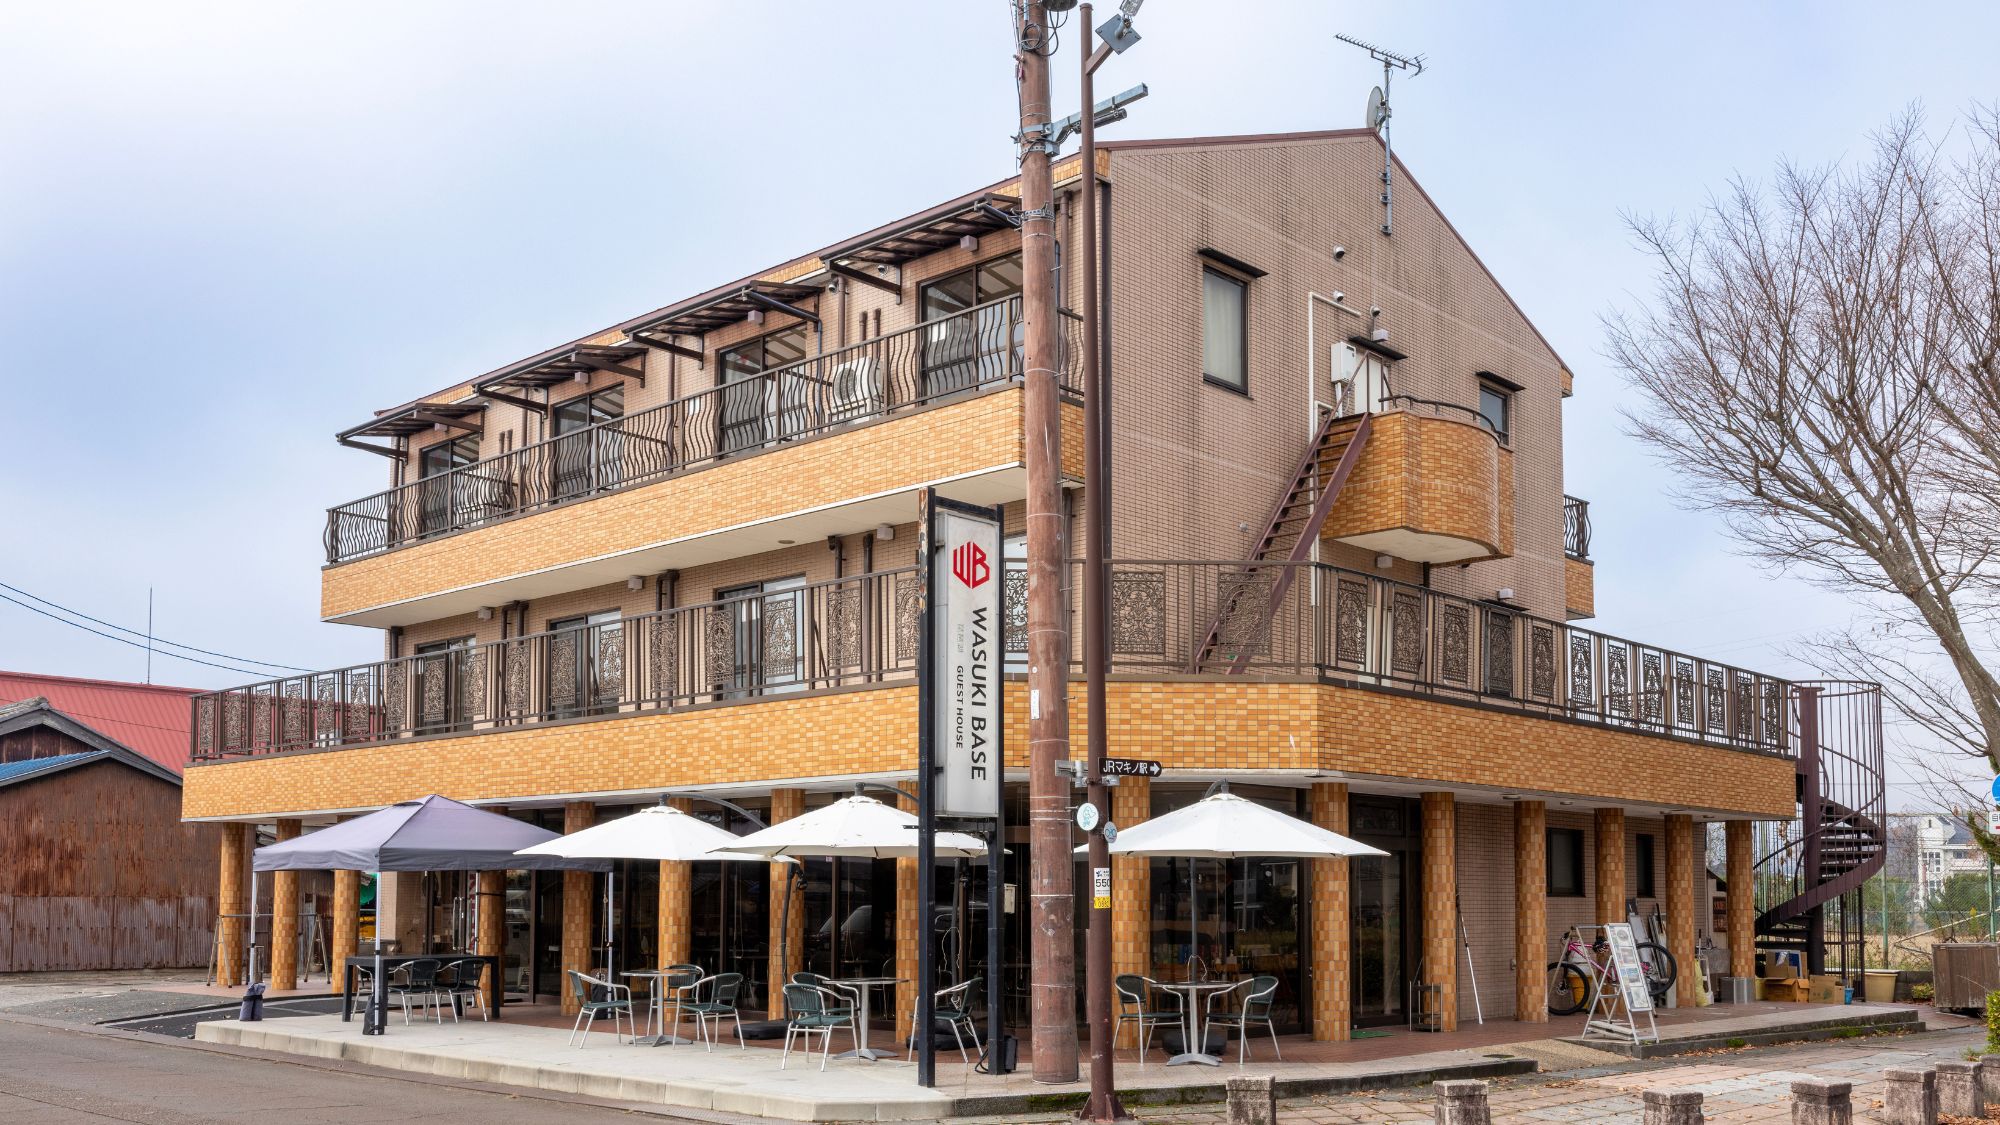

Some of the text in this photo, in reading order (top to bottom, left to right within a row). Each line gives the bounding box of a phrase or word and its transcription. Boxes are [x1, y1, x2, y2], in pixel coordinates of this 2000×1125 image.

[956, 665, 964, 749] GUEST HOUSE
[971, 607, 987, 780] WASUKI BASE
[1103, 760, 1148, 774] JRマキノ駅
